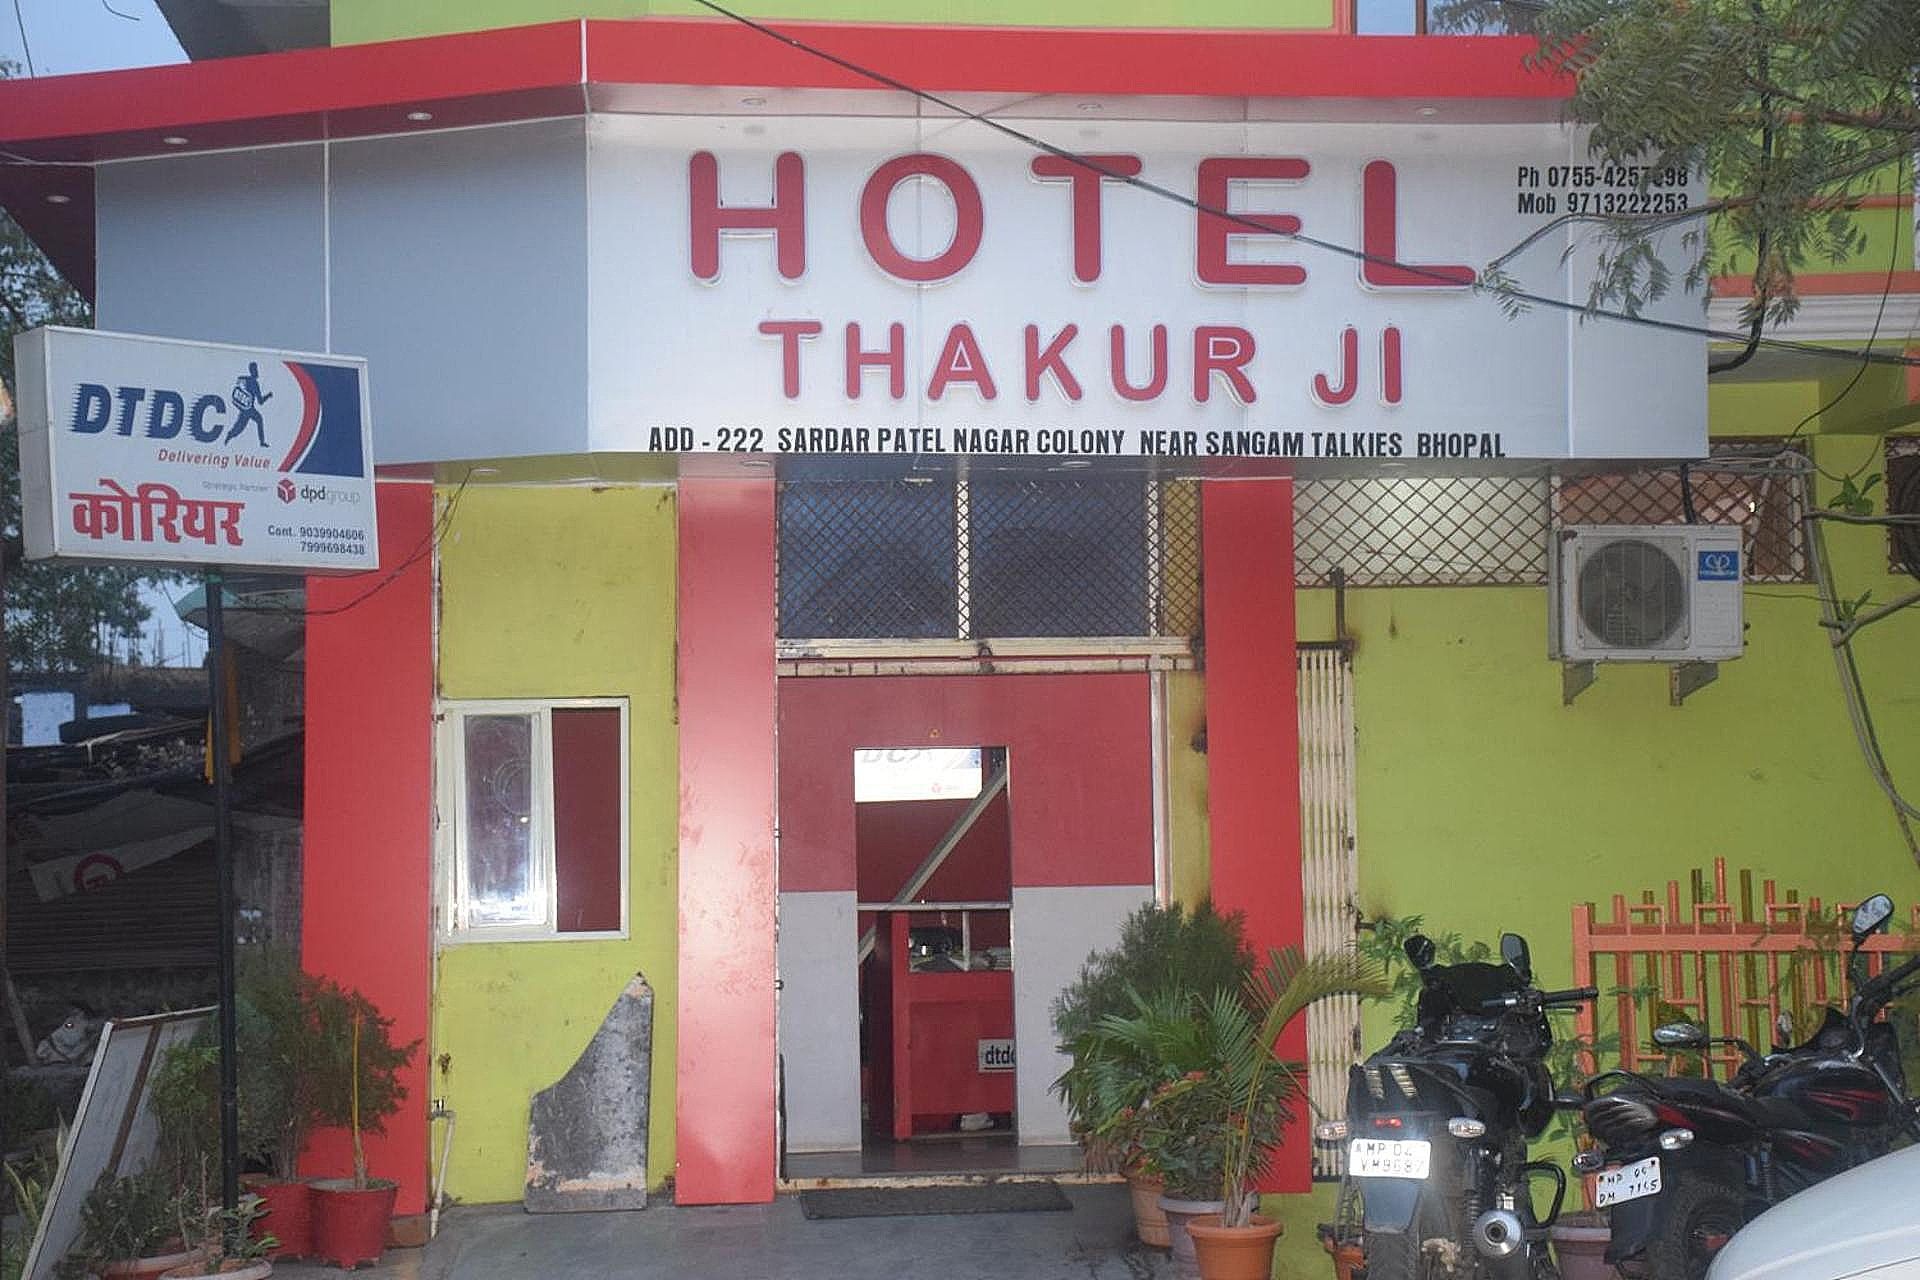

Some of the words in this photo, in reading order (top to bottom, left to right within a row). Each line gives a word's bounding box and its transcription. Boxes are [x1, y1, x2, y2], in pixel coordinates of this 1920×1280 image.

[1518, 167, 1540, 187] Ph
[689, 151, 1478, 287] HOTEL
[1518, 193, 1556, 214] Mob
[1567, 193, 1688, 215] 9713222253
[758, 321, 1257, 404] THAKUR
[1313, 326, 1402, 405] JI
[68, 383, 227, 444] DTDC
[158, 448, 230, 469] Delivering
[235, 454, 271, 469] Value
[649, 427, 694, 452] ADD
[717, 428, 764, 452] 222
[778, 428, 870, 453] SARDAR
[878, 428, 946, 453] PATEL
[953, 428, 1030, 454] NAGAR
[1037, 429, 1125, 454] COLONY
[1140, 430, 1198, 455] NEAR
[1206, 431, 1304, 457] SANGAM
[1312, 432, 1402, 457] TALKIES
[1417, 433, 1506, 458] BHOPAL
[69, 478, 245, 547] कोरियर
